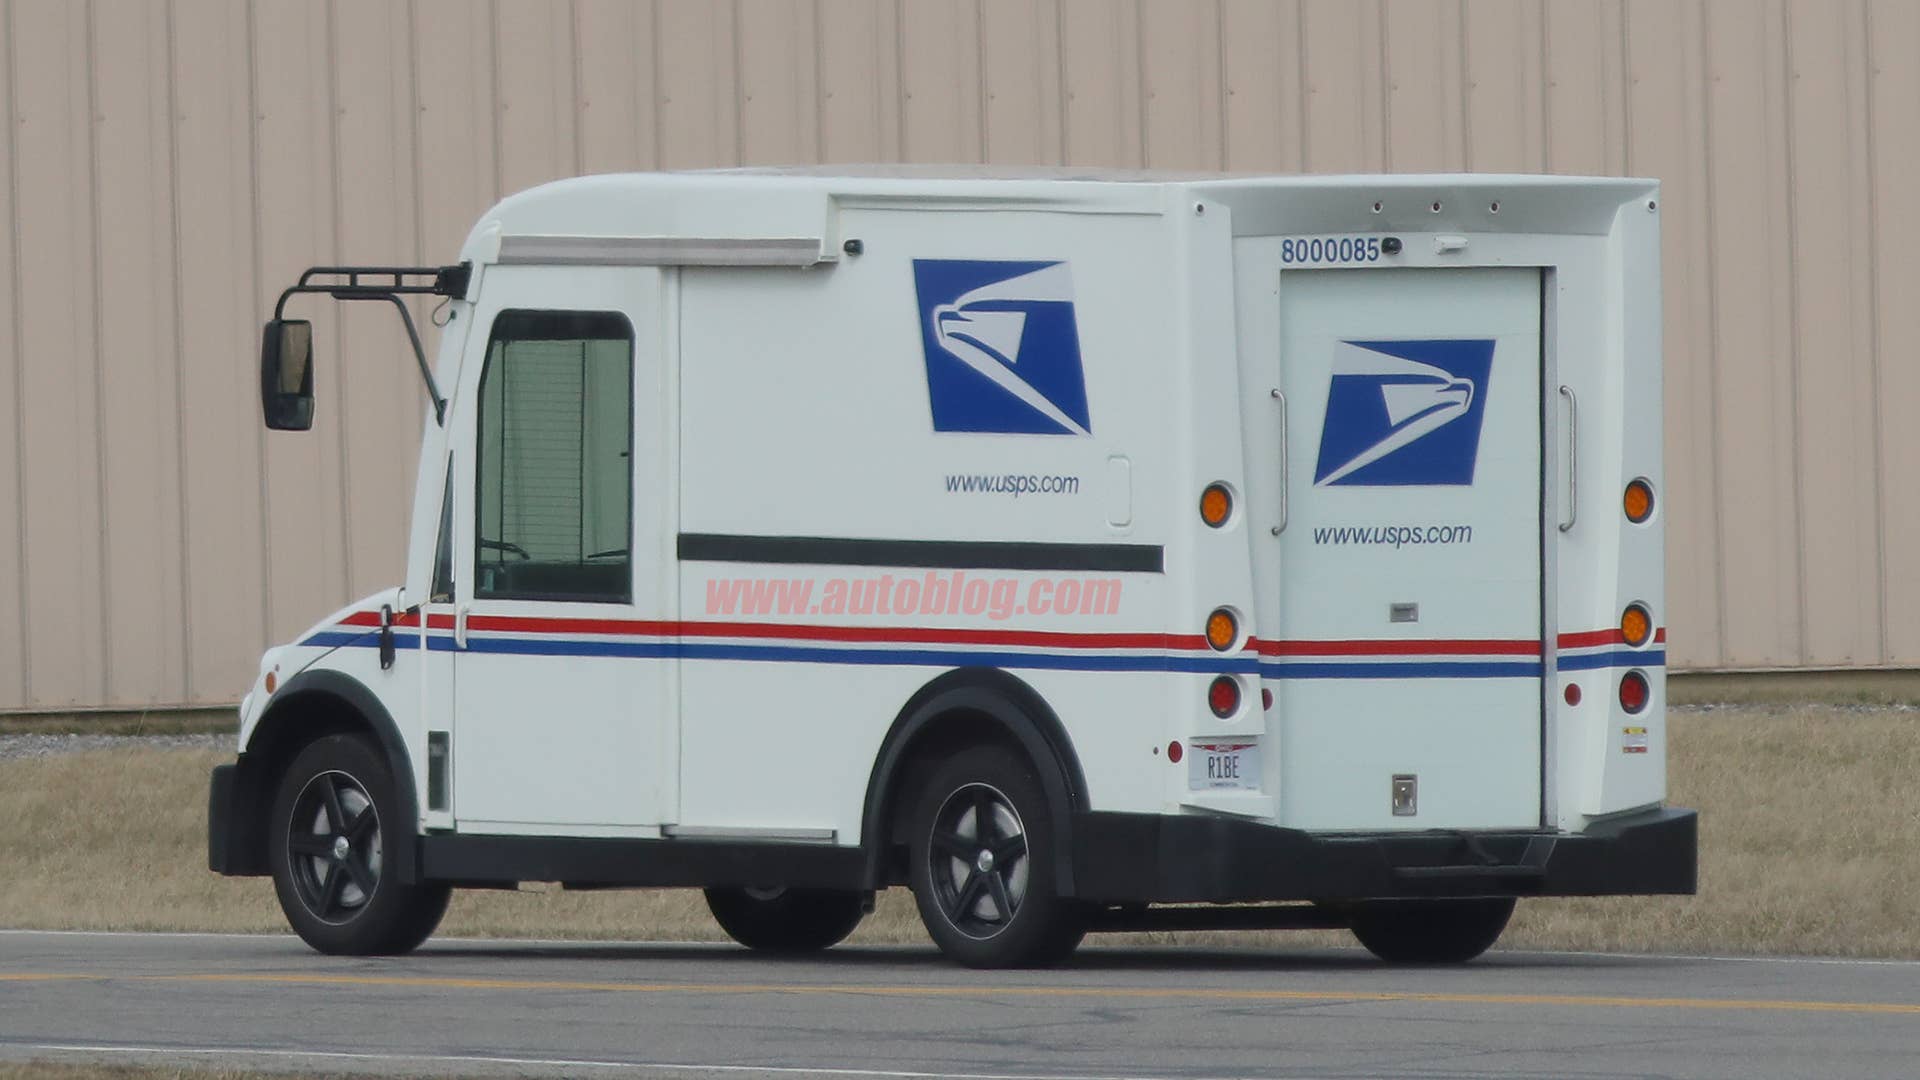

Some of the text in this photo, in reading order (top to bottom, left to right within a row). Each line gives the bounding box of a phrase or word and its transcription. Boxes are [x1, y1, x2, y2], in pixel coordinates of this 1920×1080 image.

[1282, 238, 1379, 263] 8000085
[945, 475, 1079, 498] www.usps.com
[1313, 525, 1473, 549] www.usps.com
[1208, 755, 1240, 778] R1BE
